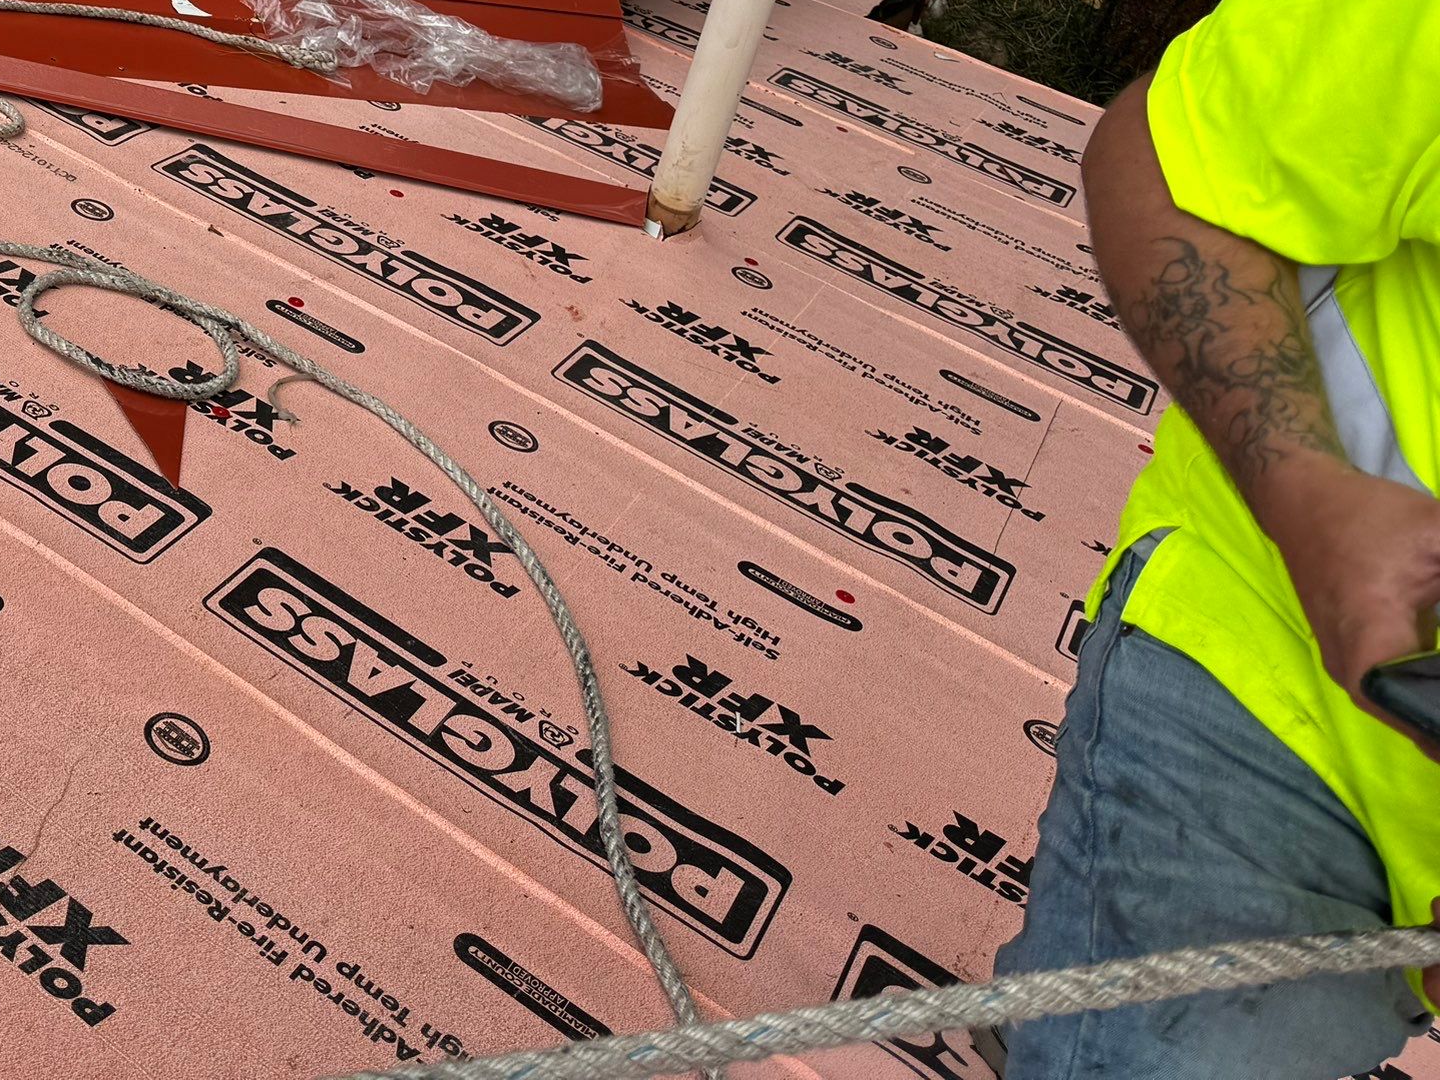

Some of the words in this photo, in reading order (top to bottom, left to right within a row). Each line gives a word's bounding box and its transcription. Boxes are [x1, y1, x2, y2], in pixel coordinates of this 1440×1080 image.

[175, 161, 508, 333] POLYGLASS
[446, 212, 593, 285] POLYSTICK
[478, 212, 593, 268] XFR
[844, 189, 944, 237] XFR
[626, 299, 782, 386] POLYSTICK
[657, 299, 775, 363] XFR
[800, 232, 1134, 402] POLYGLASS
[586, 366, 984, 595] POLYGLASS
[738, 422, 811, 464] MAPEI
[870, 429, 1047, 523] POLYSTICK
[905, 425, 1033, 494] XFR
[330, 480, 521, 600] POLYSTICK
[374, 476, 517, 568] XFR
[485, 485, 629, 573] Fire-Resistant
[502, 479, 654, 571] Underlayment
[631, 571, 782, 662] Self-Adhered
[660, 571, 729, 612] Temp
[728, 609, 782, 647] High
[447, 667, 534, 725] MAPEI
[628, 660, 846, 796] POLYSTICK
[672, 652, 834, 757] XFR
[241, 586, 746, 923] POLYGLASS
[112, 828, 289, 968] Fire-Resistant
[138, 815, 328, 964] Underlayment
[898, 820, 1029, 904] STICK
[336, 960, 411, 1028] Temp
[469, 946, 524, 988] COUNTY
[512, 964, 566, 1006] APPROVED
[288, 963, 428, 1065] -Adhered
[518, 985, 601, 1040] MIAMI-DADE
